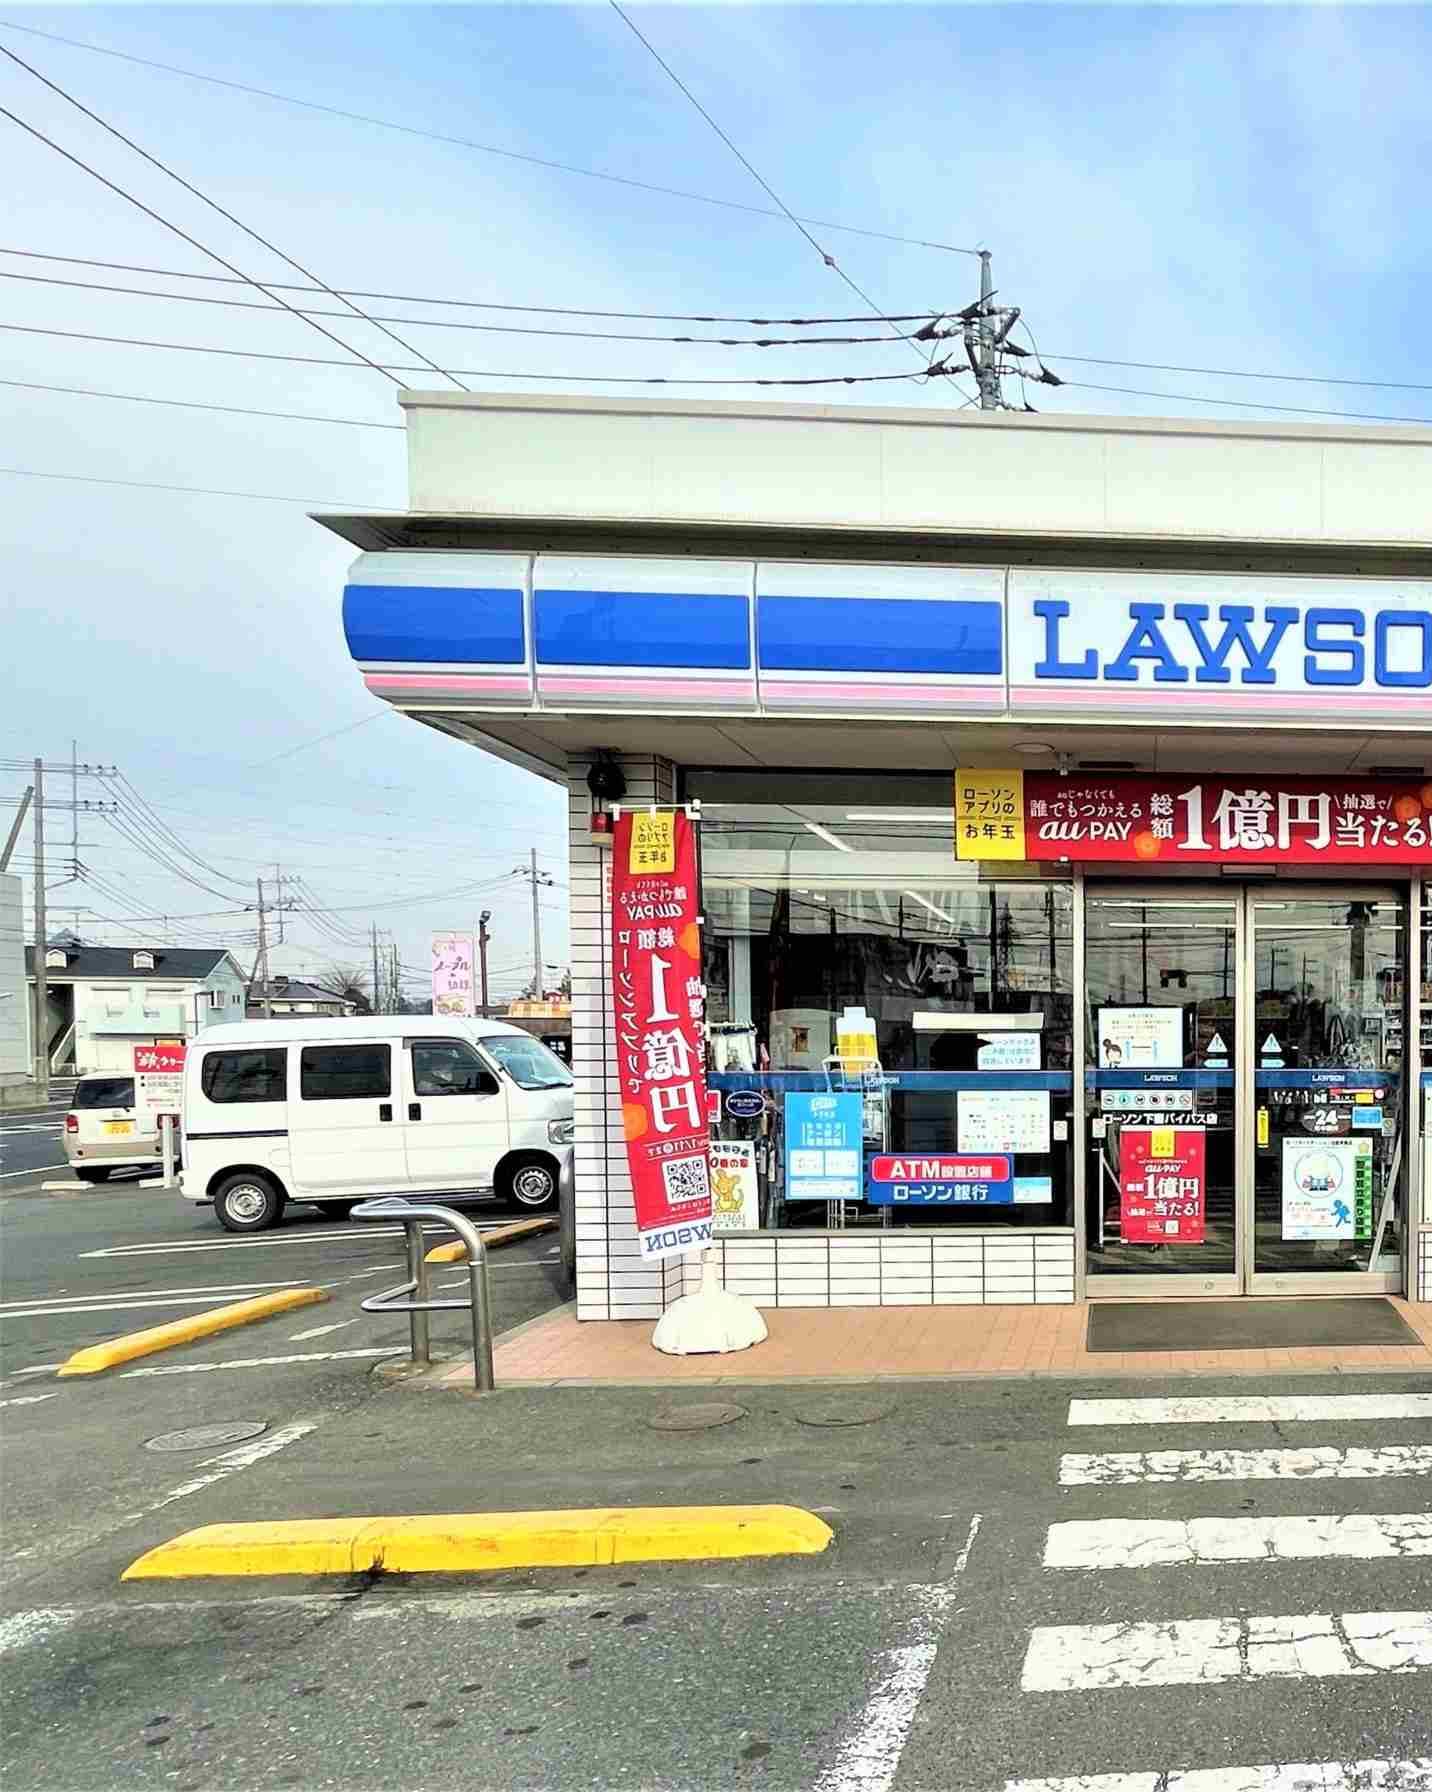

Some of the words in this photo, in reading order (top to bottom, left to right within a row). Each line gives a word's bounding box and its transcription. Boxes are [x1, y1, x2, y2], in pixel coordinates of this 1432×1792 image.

[963, 788, 1016, 800] ローソン
[964, 801, 1016, 814] アプリの
[1030, 799, 1143, 819] 誰でもつかえる
[1150, 792, 1175, 840] 総額
[1176, 784, 1332, 851] 1億円
[966, 823, 1016, 840] お年玉
[1089, 822, 1133, 841] PAY
[1314, 1109, 1339, 1125] 24
[893, 1184, 989, 1201] ローソン銀行
